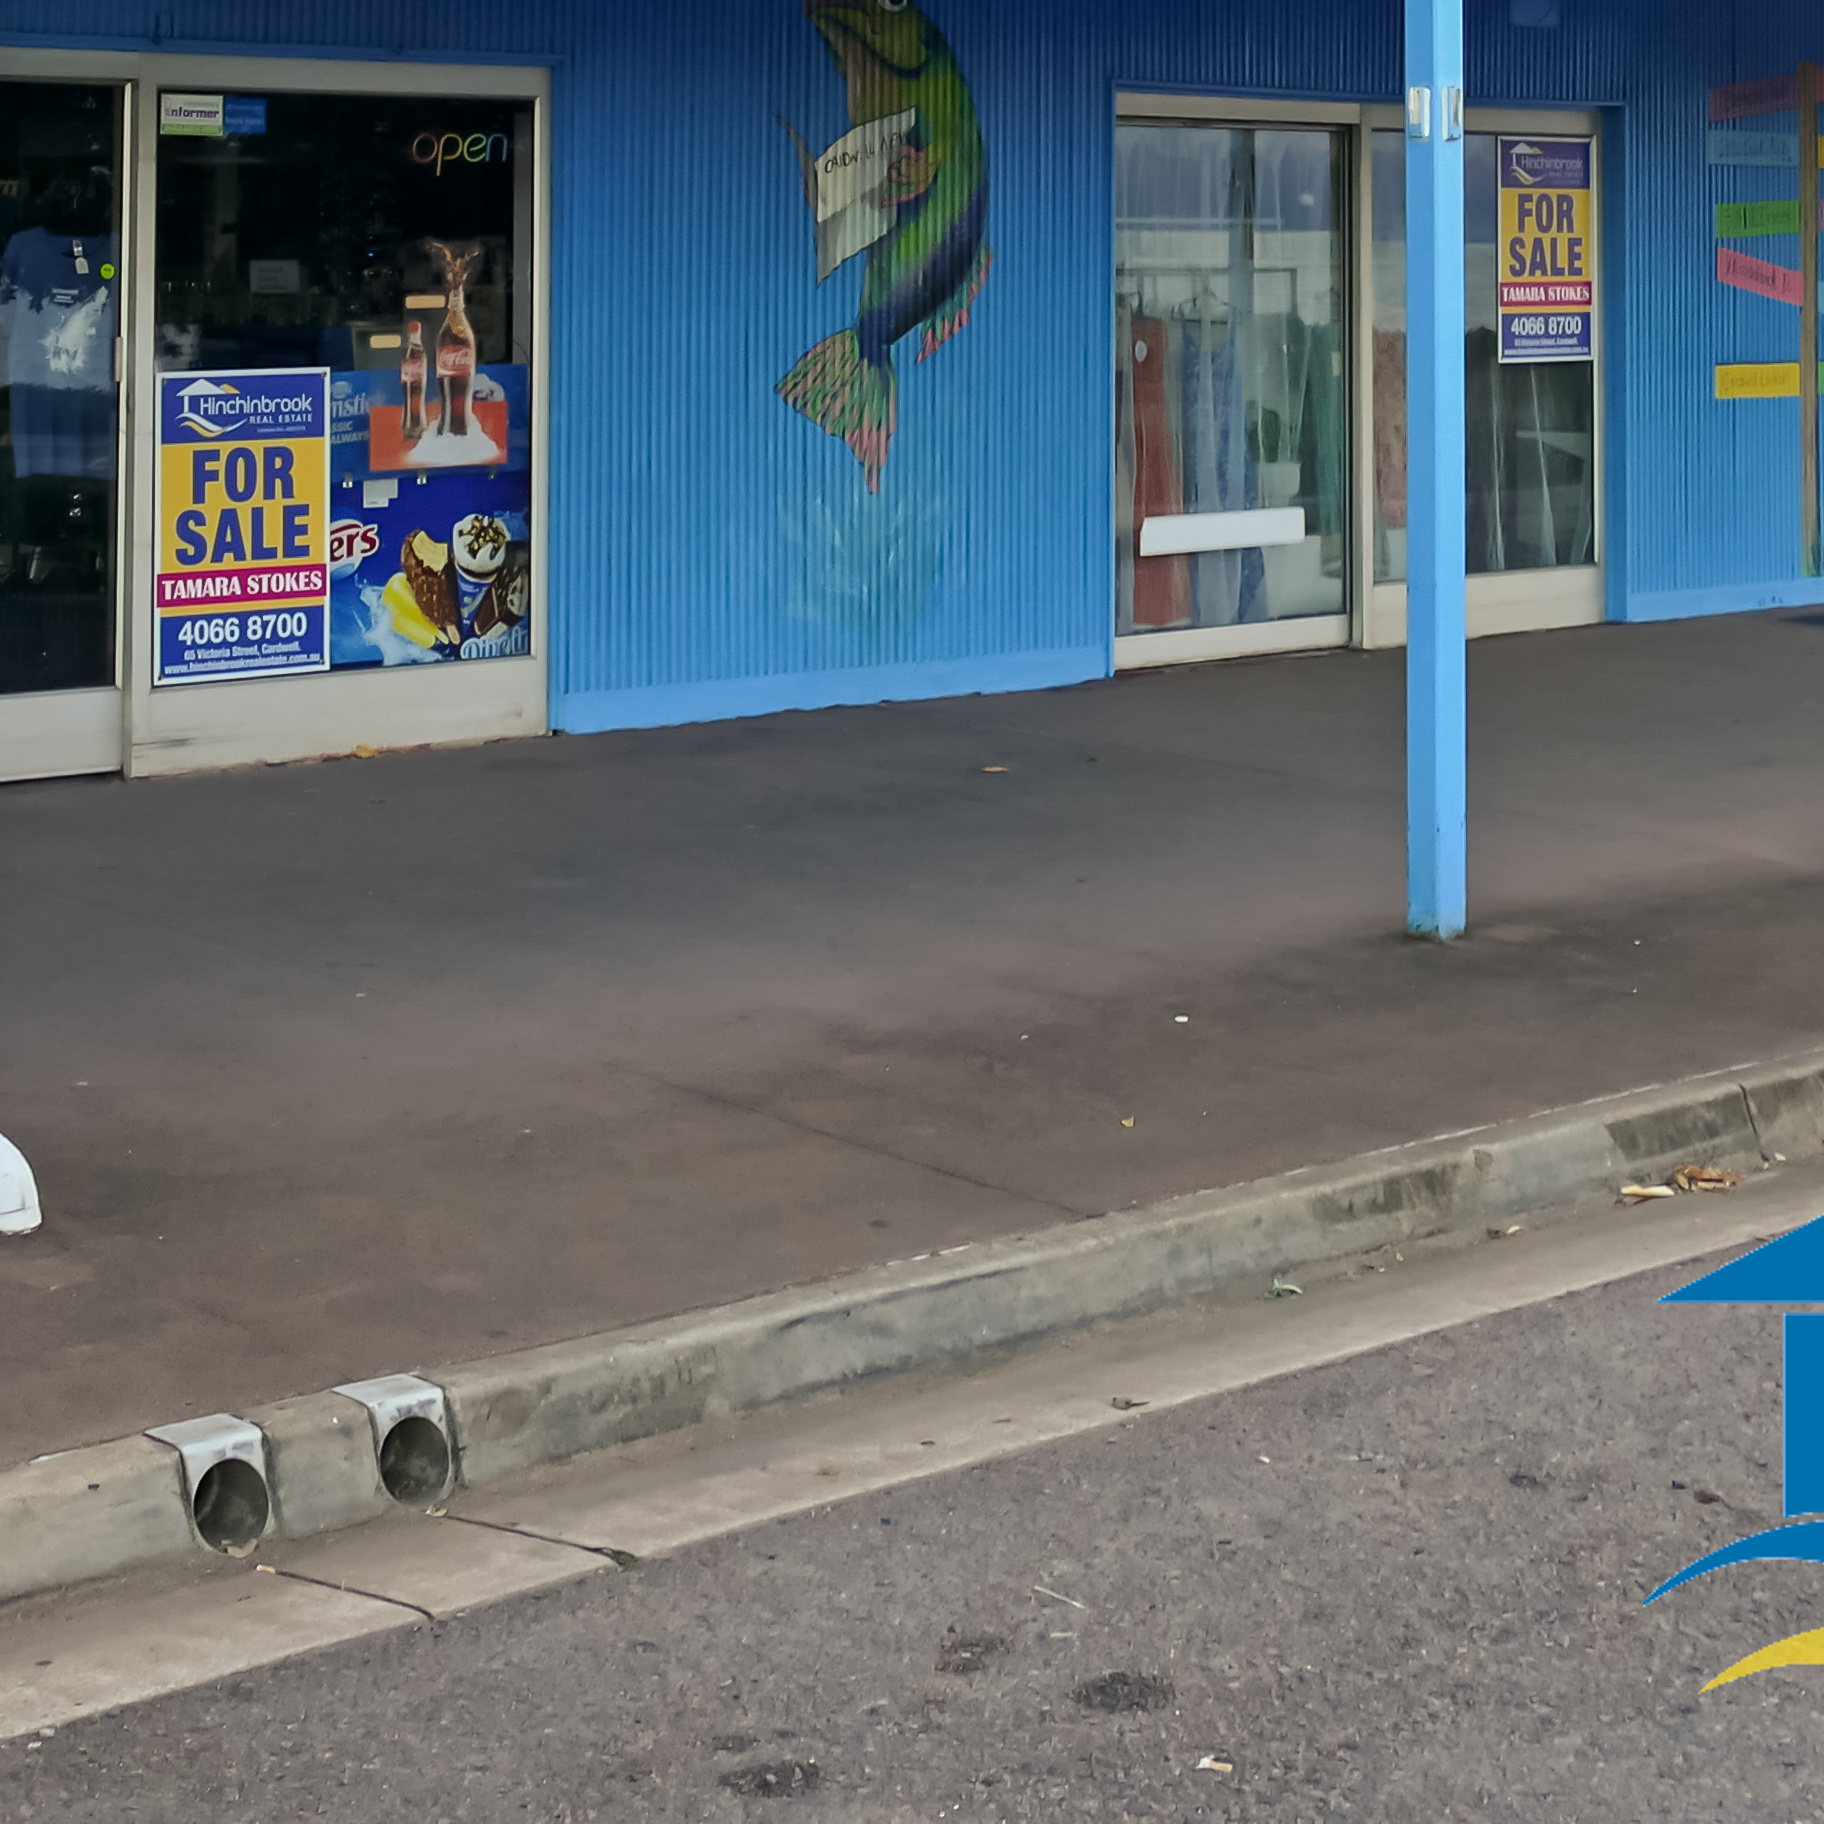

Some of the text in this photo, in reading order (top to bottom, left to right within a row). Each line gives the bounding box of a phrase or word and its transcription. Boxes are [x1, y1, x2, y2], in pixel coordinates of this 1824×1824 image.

[412, 133, 508, 177] open
[1521, 152, 1583, 170] Hinchinbrook
[1517, 192, 1575, 235] FOR
[1508, 236, 1584, 278] SALE
[1502, 286, 1590, 302] TAMARA STOKES
[1510, 316, 1583, 337] 4066 8700
[199, 392, 313, 416] Hinchinbrook
[249, 413, 313, 424] REAL ESTATE
[191, 445, 295, 506] FOR
[174, 503, 312, 566] SALE
[161, 570, 323, 601] TAMARA STOKES
[178, 611, 308, 646] 4066 8700
